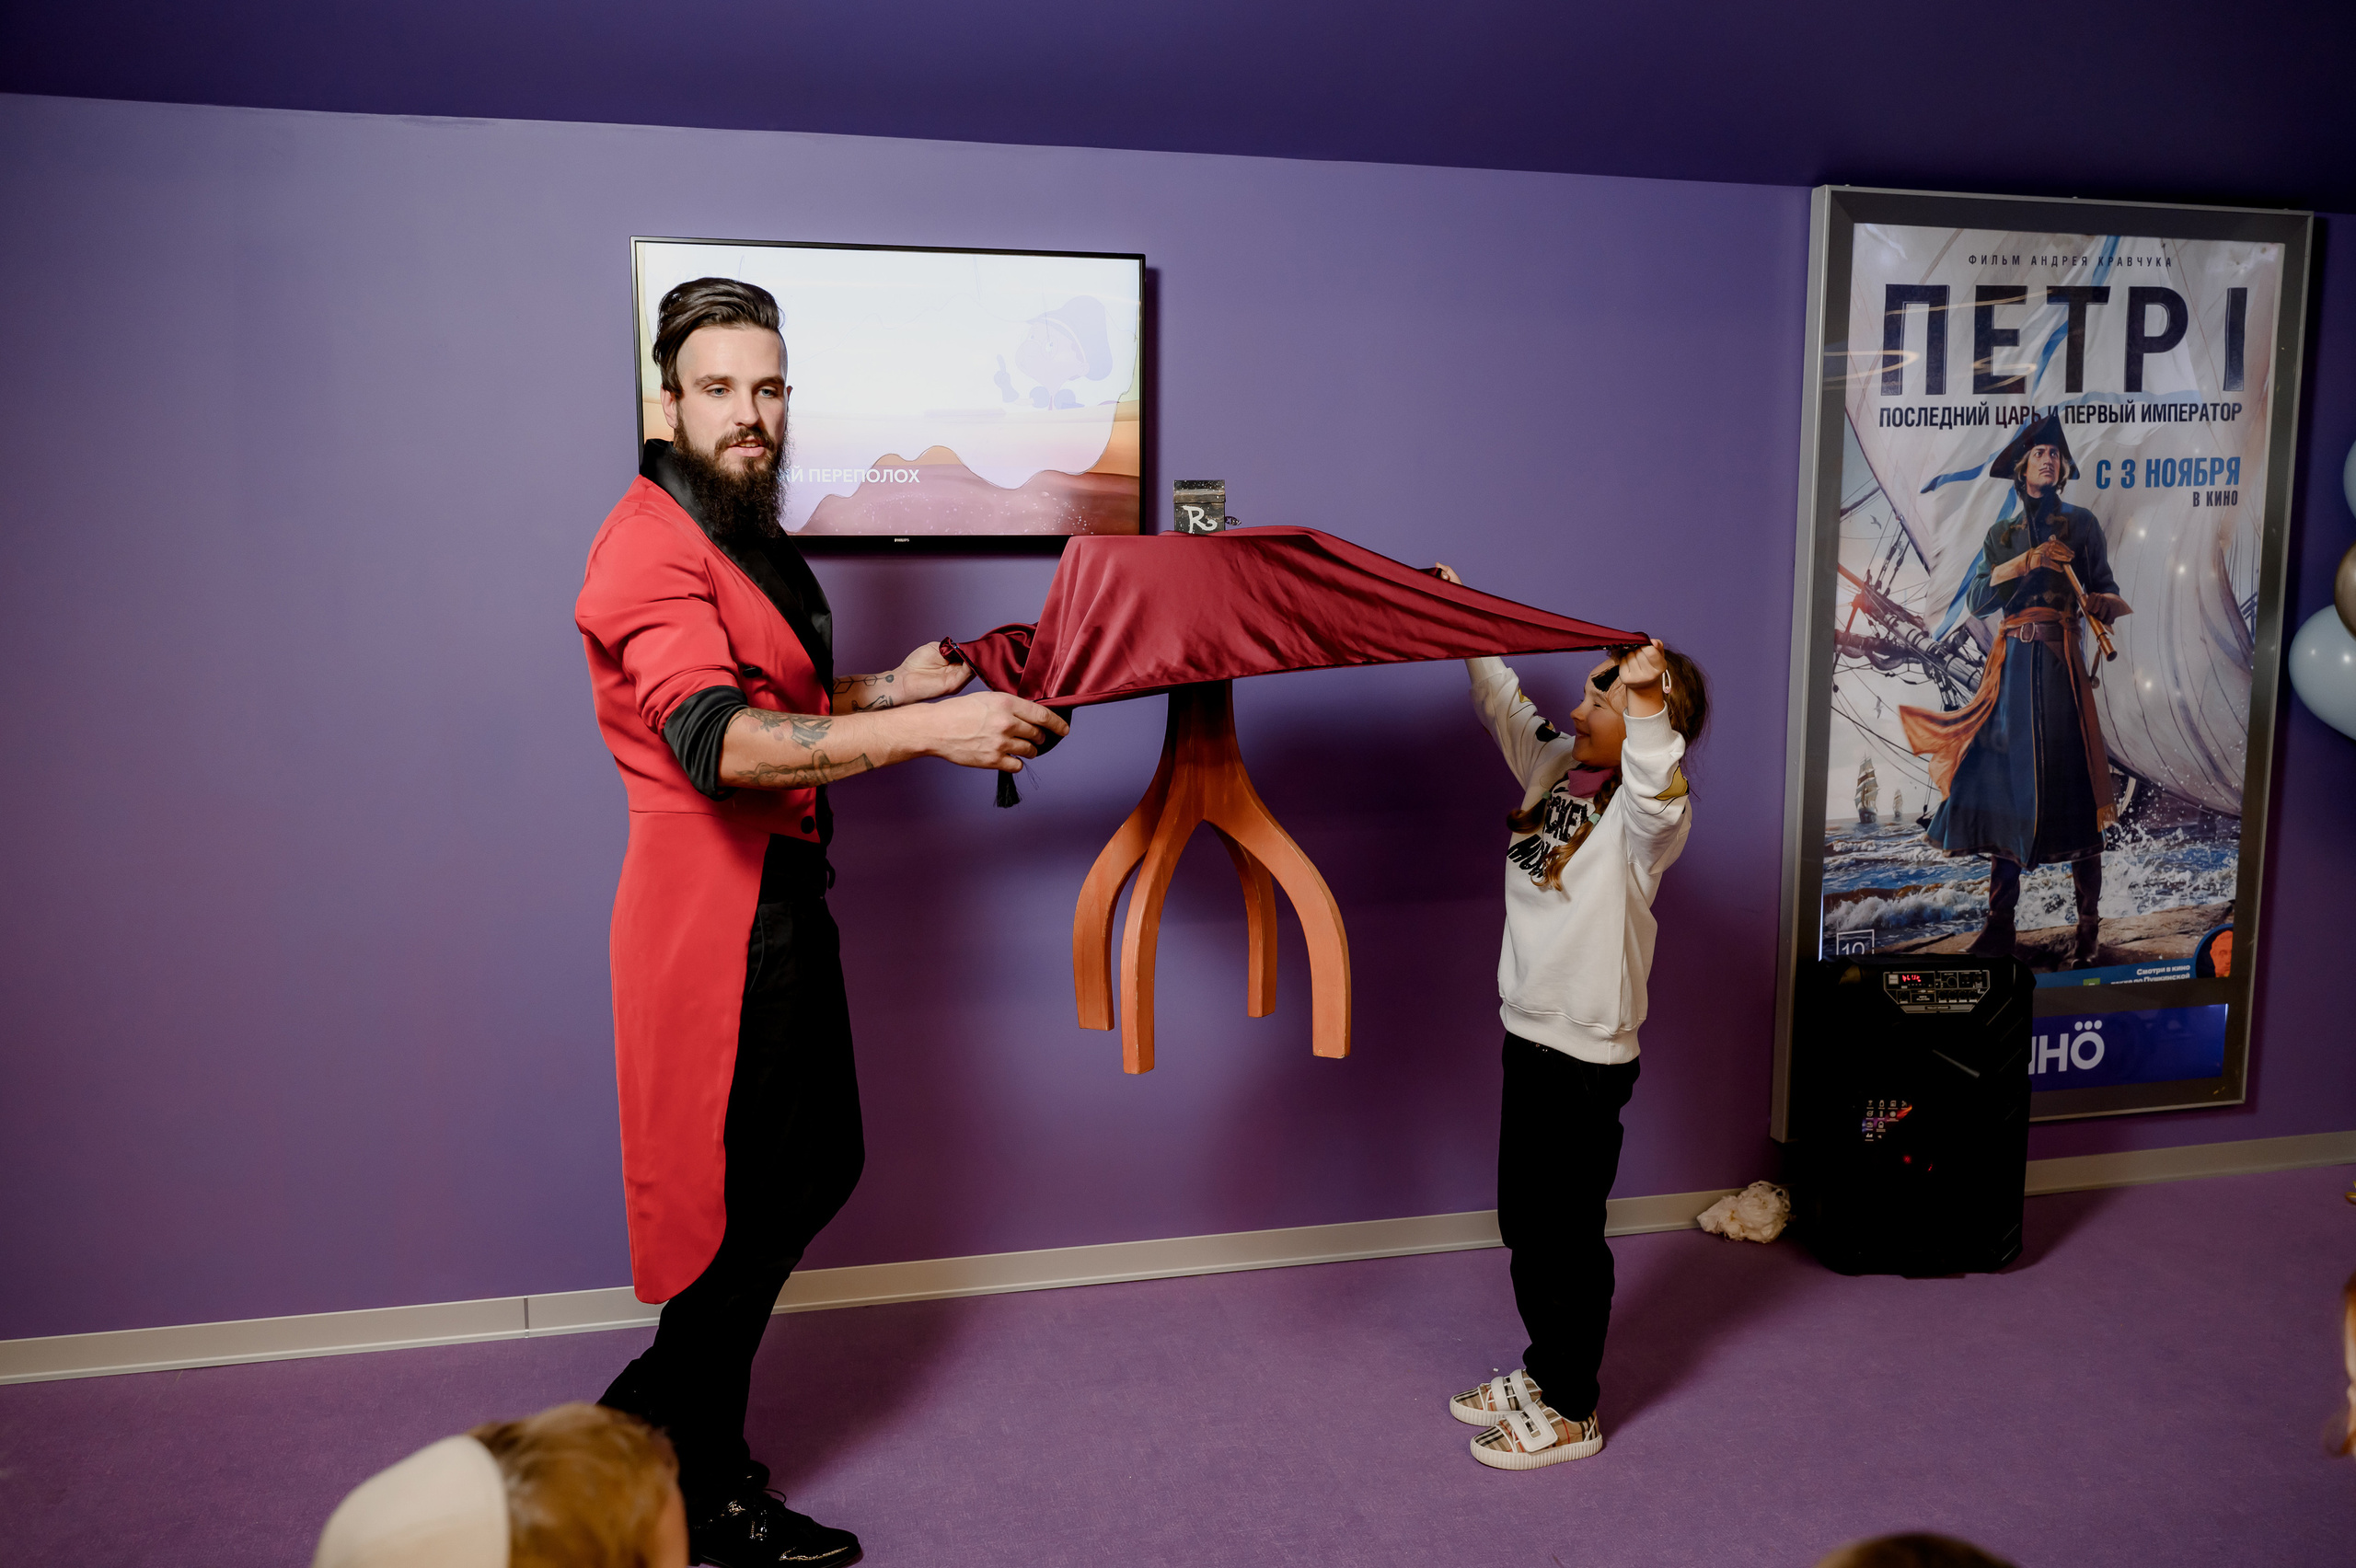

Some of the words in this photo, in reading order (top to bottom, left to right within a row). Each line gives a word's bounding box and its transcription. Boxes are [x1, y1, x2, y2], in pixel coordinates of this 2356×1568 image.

[1968, 254, 2021, 266] ФИЛЬМ
[2030, 255, 2089, 268] АНДРЕЯ
[2097, 255, 2173, 268] КРАВЧУКА
[1880, 283, 2189, 397] ПЕТР
[1878, 401, 1991, 431] ПОСЛЕДНИЙ
[1995, 405, 2042, 430] ЦАРЬ
[2064, 399, 2136, 424] ПЕРВЫЙ
[2141, 402, 2243, 423] ИМПЕРАТОР
[808, 467, 921, 484] ПЕРЕПОЛОХ
[2096, 458, 2112, 490] С
[2120, 458, 2136, 490] 3
[2144, 456, 2241, 489] НОЯБРЯ
[2192, 490, 2200, 508] В
[2206, 490, 2239, 507] КИНО
[1181, 505, 1218, 534] R
[2136, 966, 2165, 975] Смотри
[2171, 964, 2191, 973] кино
